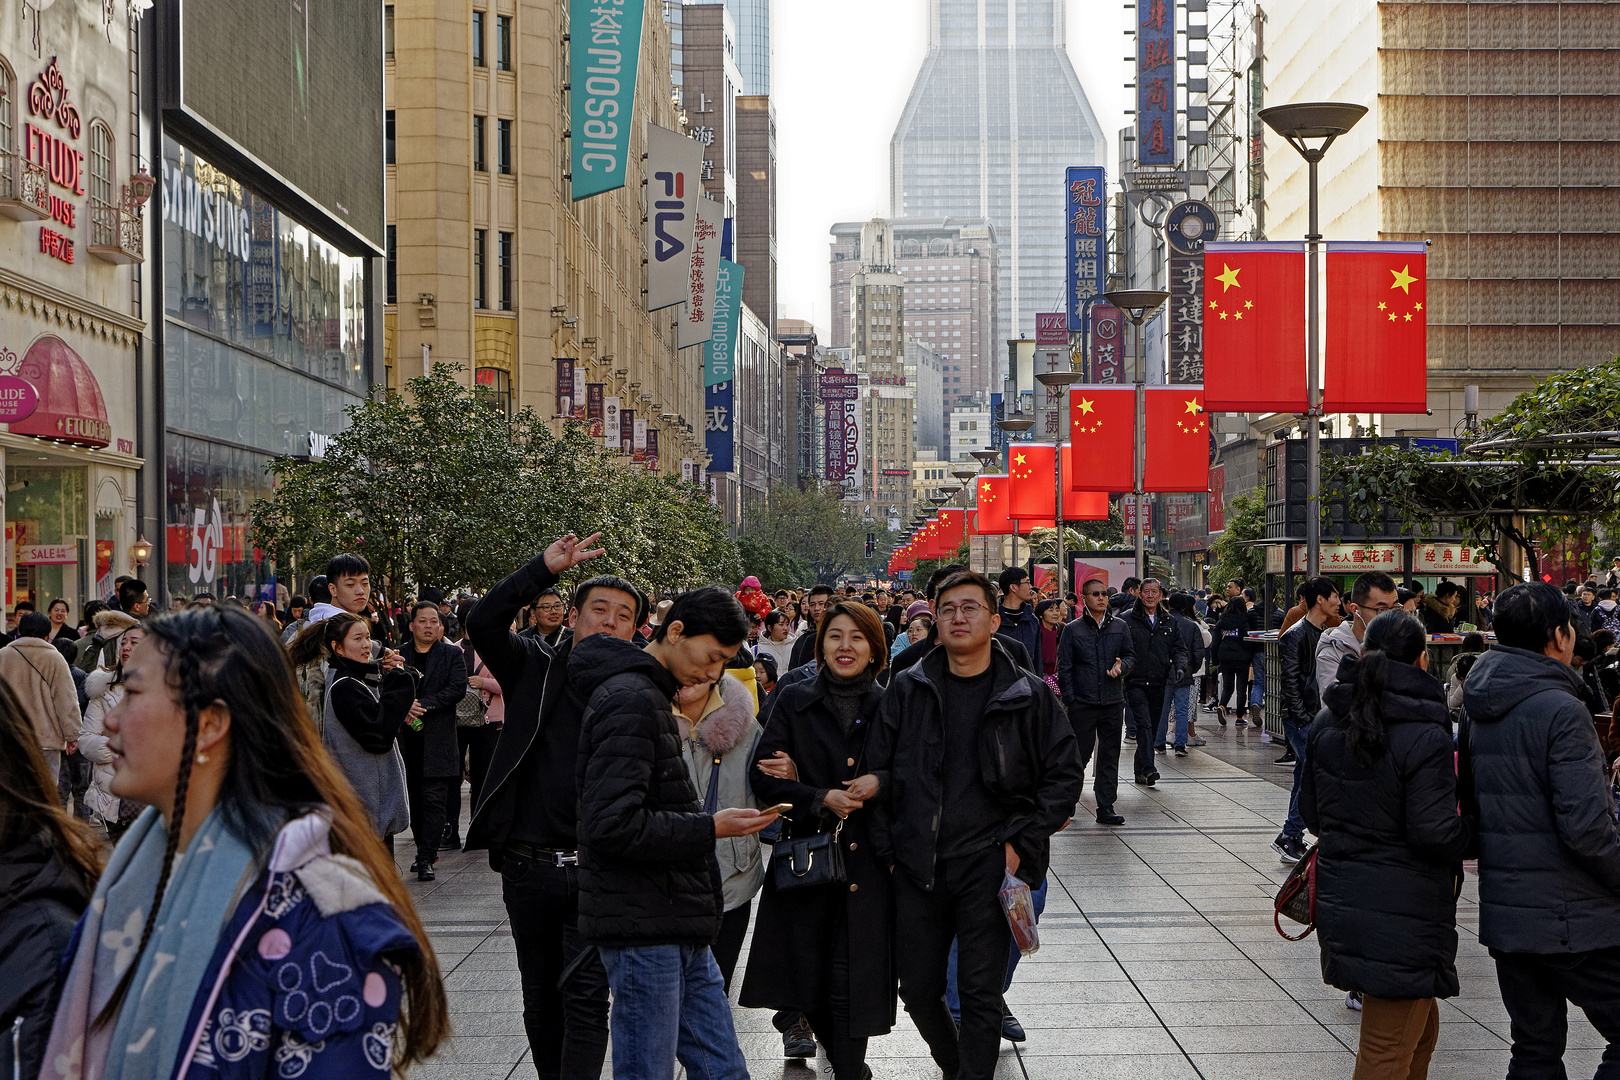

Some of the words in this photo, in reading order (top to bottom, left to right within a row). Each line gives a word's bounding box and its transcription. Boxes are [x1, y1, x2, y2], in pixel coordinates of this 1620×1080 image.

[25, 123, 85, 196] ETUDE
[162, 157, 250, 263] SAMSUNG
[654, 171, 685, 262] FILA
[1168, 224, 1179, 232] IX
[1184, 205, 1198, 214] XII
[32, 548, 55, 560] SALE
[189, 506, 218, 584] 5G
